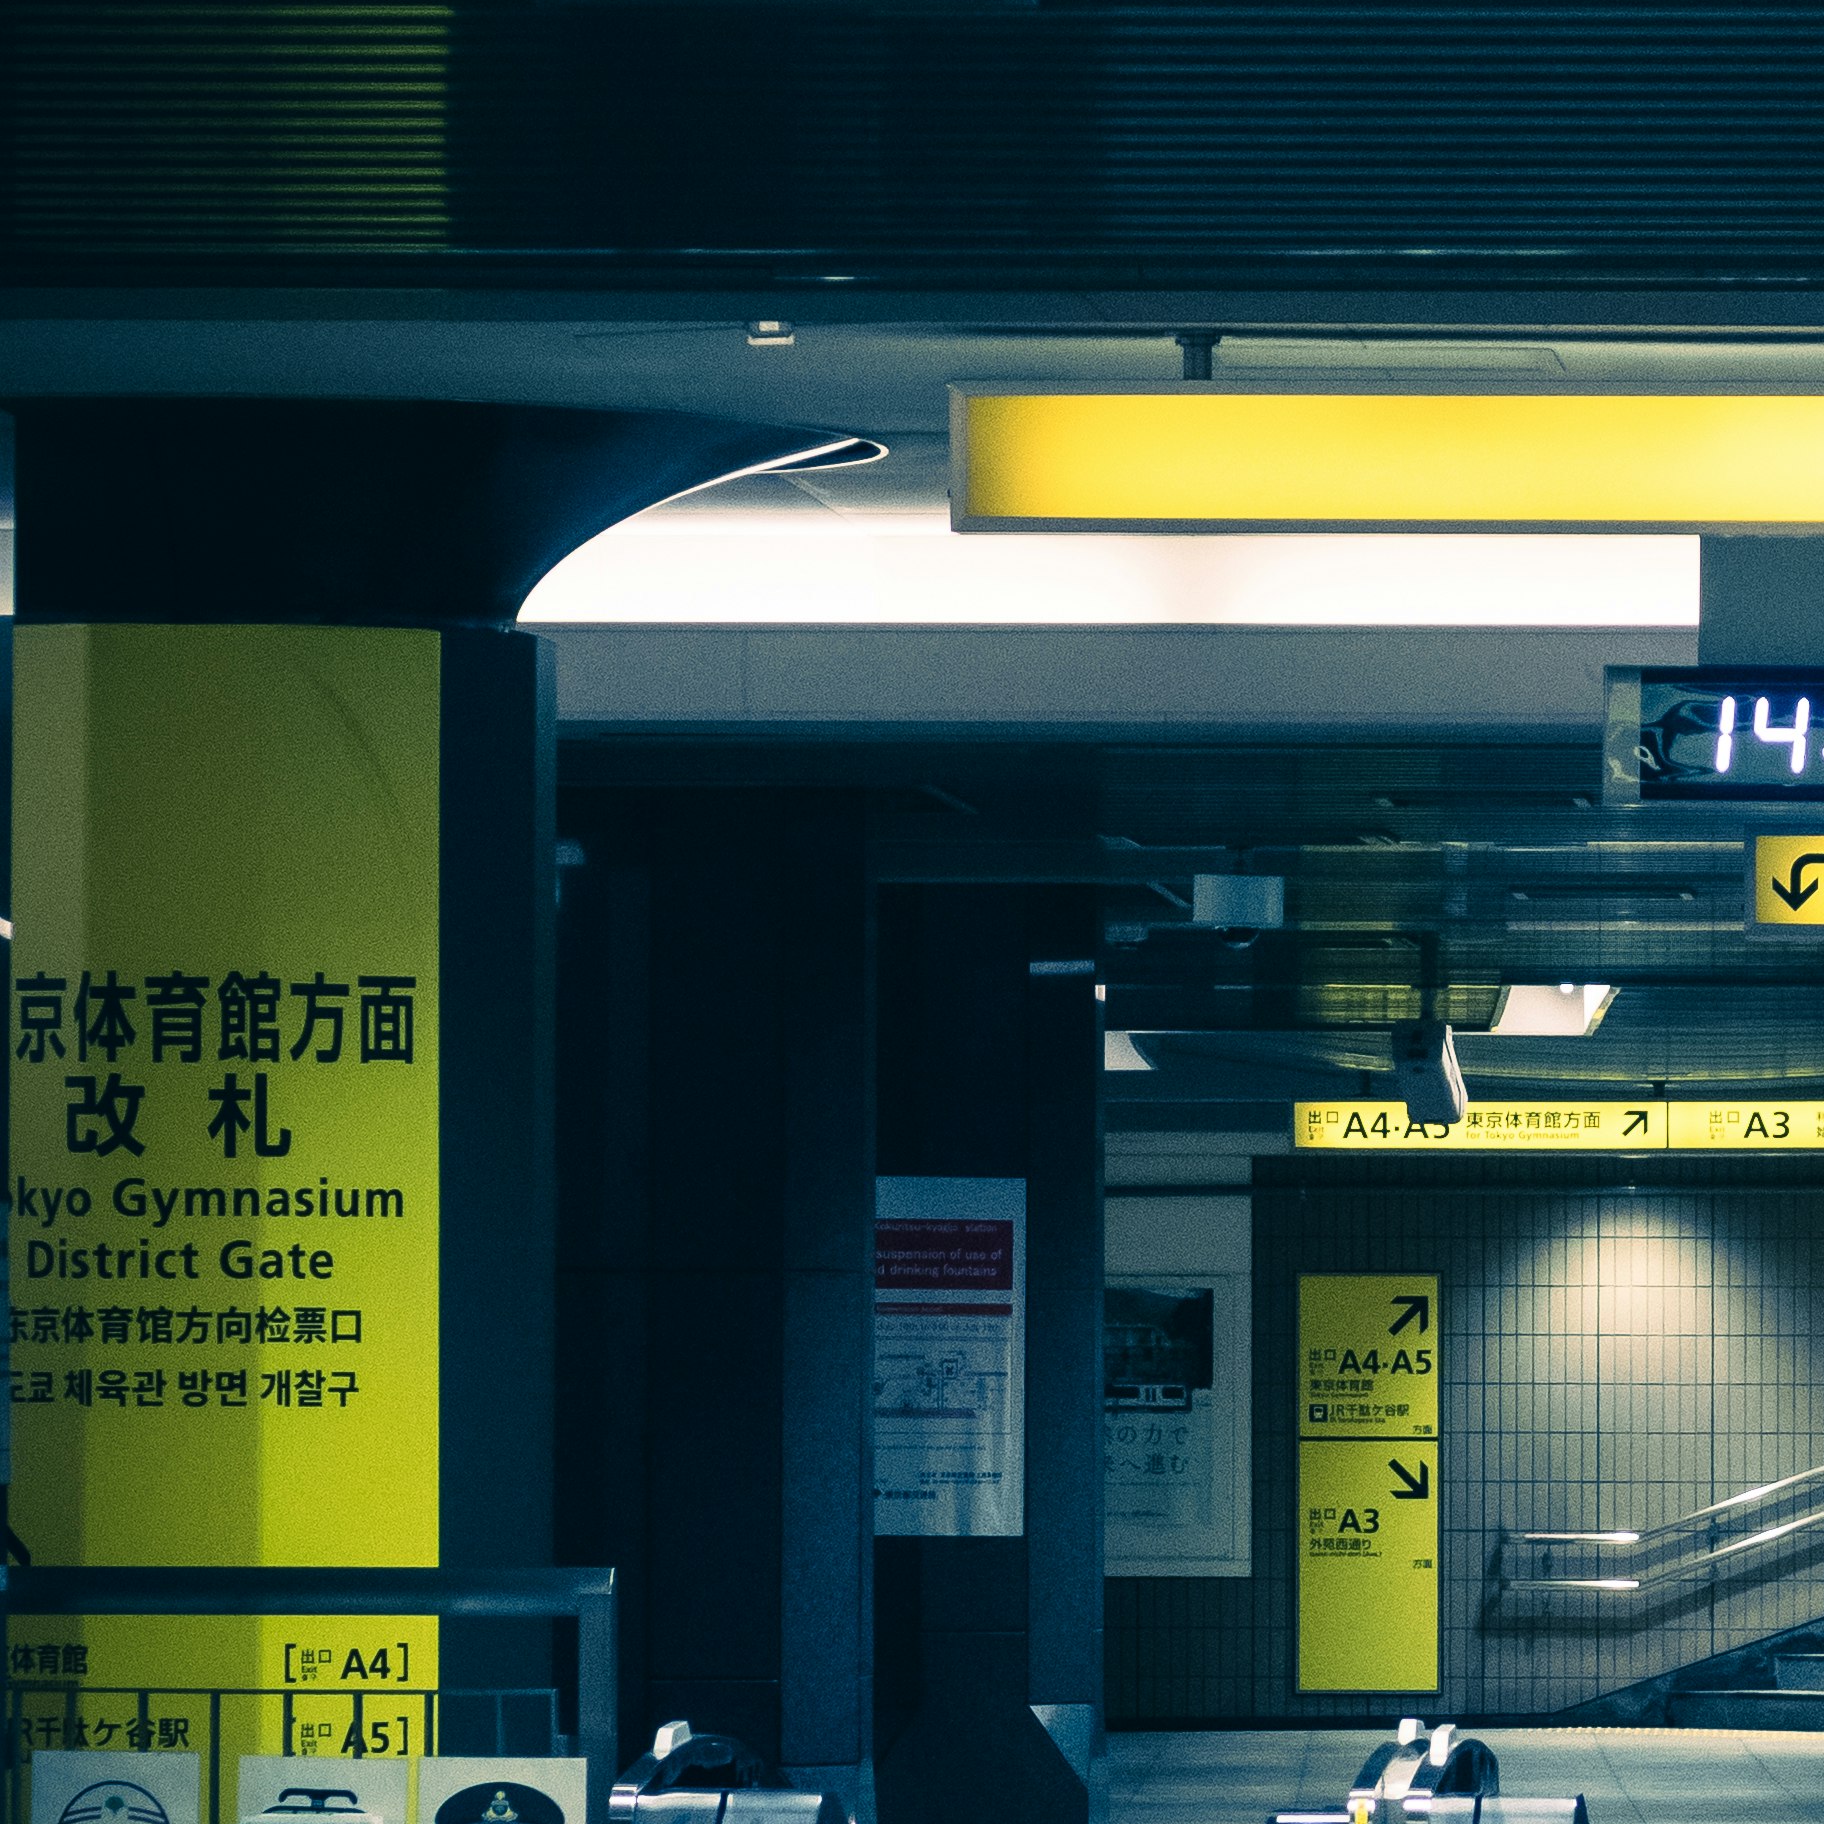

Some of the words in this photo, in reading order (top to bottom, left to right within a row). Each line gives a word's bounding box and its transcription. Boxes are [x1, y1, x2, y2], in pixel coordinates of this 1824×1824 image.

[15, 970, 417, 1064] 京体育館方面
[1308, 1111, 1339, 1124] 出口
[1466, 1111, 1601, 1129] 東京体育館方面
[1709, 1111, 1740, 1124] 出口
[1744, 1111, 1790, 1139] A3
[1485, 1131, 1515, 1142] Tokyo
[1518, 1131, 1580, 1142] Gymnasium
[113, 1177, 404, 1228] Gymnasium
[27, 1238, 199, 1280] District
[220, 1239, 335, 1280] Gate
[890, 1264, 940, 1277] drinking
[1309, 1348, 1336, 1361] 出口
[64, 1368, 166, 1408] 체육관
[177, 1368, 247, 1408] 방면
[261, 1368, 360, 1408] 개찰구
[1309, 1508, 1336, 1520] 出口
[1338, 1508, 1379, 1534] A3
[7, 1643, 88, 1675] 体育館
[301, 1649, 332, 1663] 出口
[301, 1723, 332, 1737] 出口
